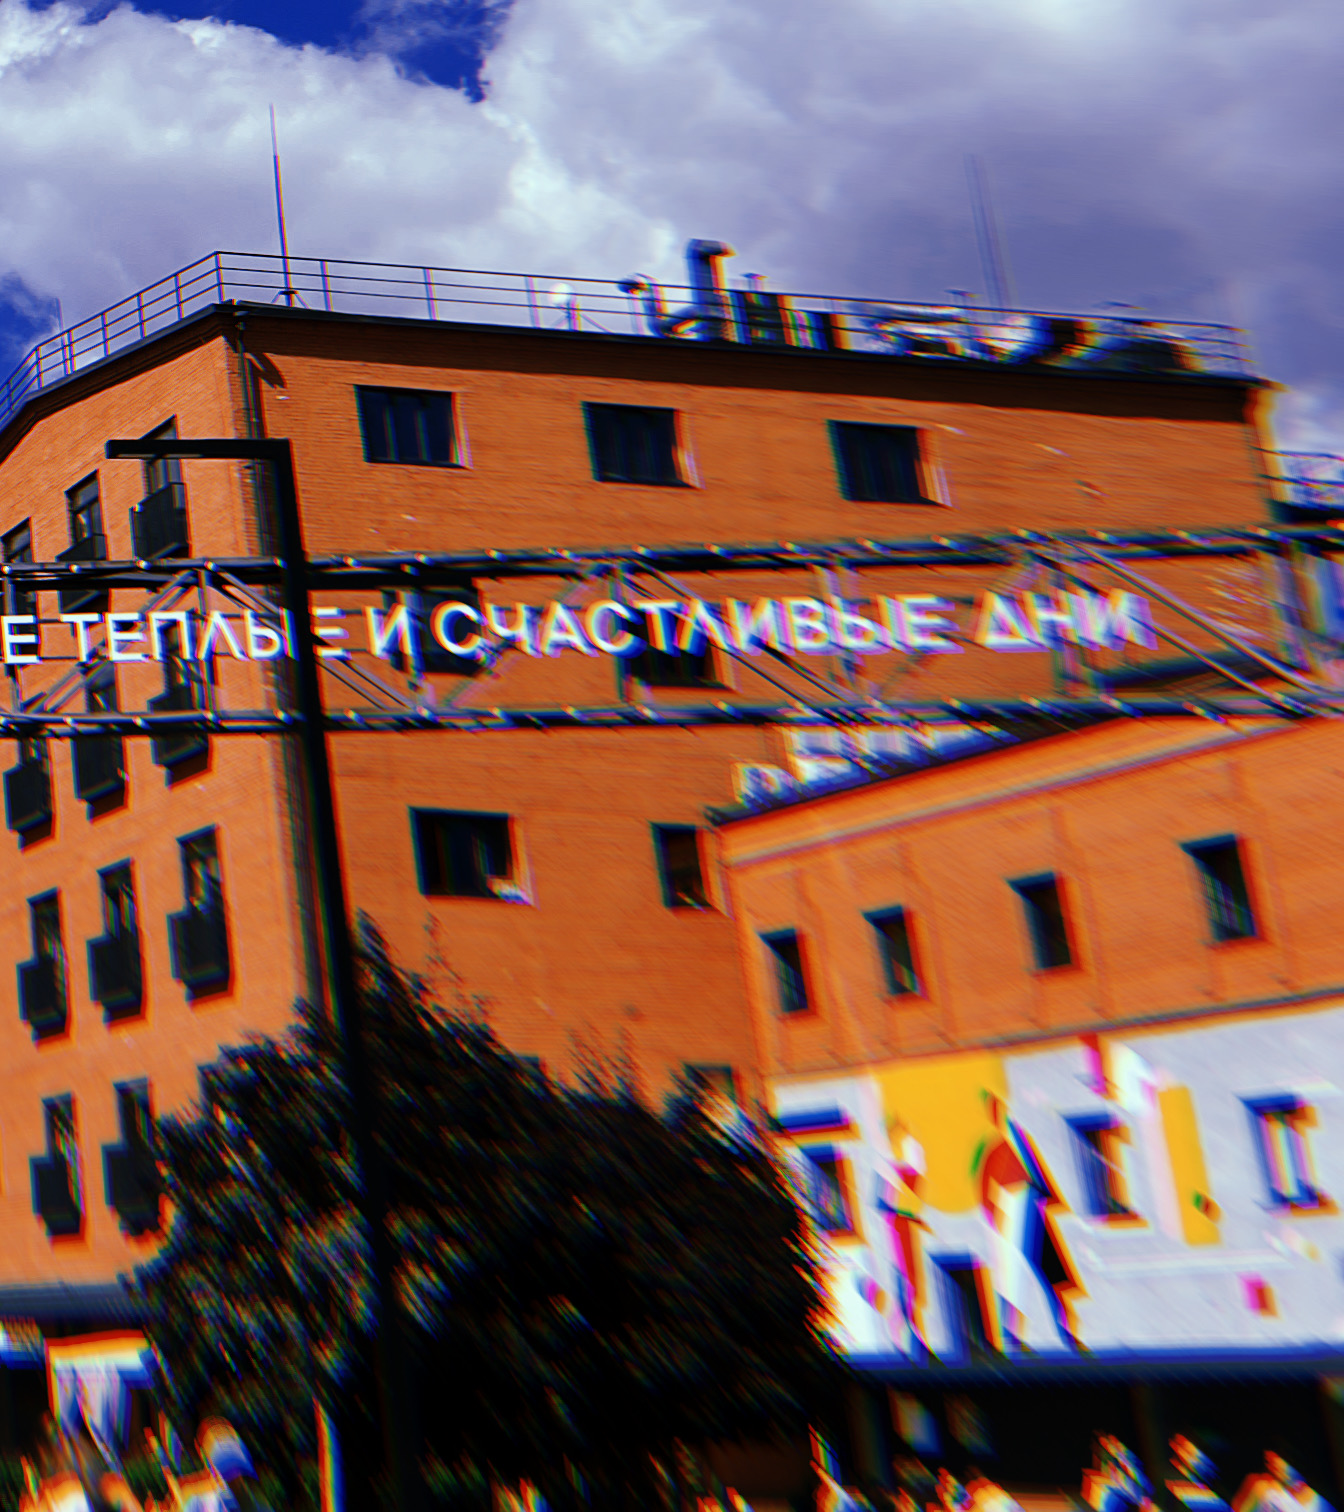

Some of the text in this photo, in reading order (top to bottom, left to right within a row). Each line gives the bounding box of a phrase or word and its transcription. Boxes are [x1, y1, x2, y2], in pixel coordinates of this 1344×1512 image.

[60, 606, 352, 664] ТЕПЛЫЕ
[364, 602, 424, 660] И
[430, 593, 964, 658] СЧАСТЛИВЫЕ
[972, 587, 1159, 653] ДНИ
